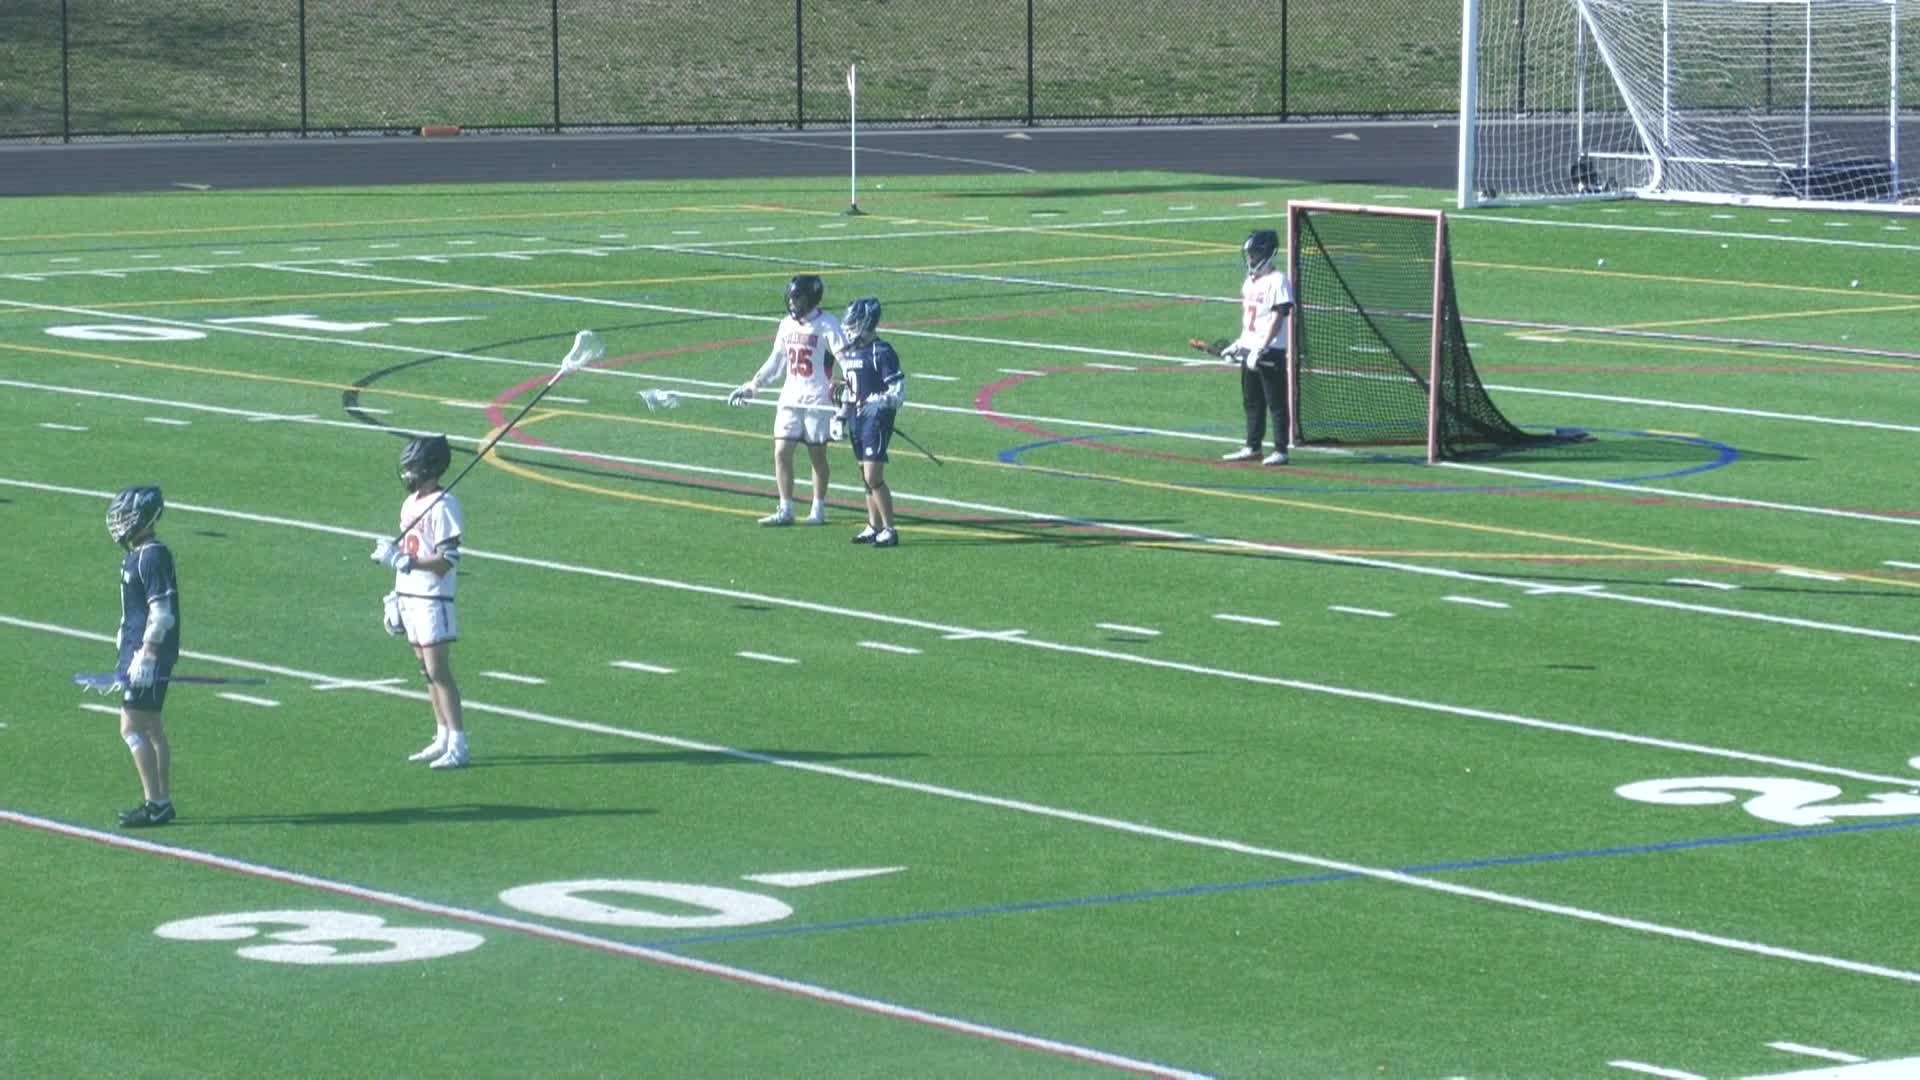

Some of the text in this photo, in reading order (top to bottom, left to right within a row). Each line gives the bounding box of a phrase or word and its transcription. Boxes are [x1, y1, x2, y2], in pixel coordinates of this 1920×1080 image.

[1248, 304, 1257, 332] 7
[788, 347, 813, 378] 25
[154, 879, 794, 965] 30
